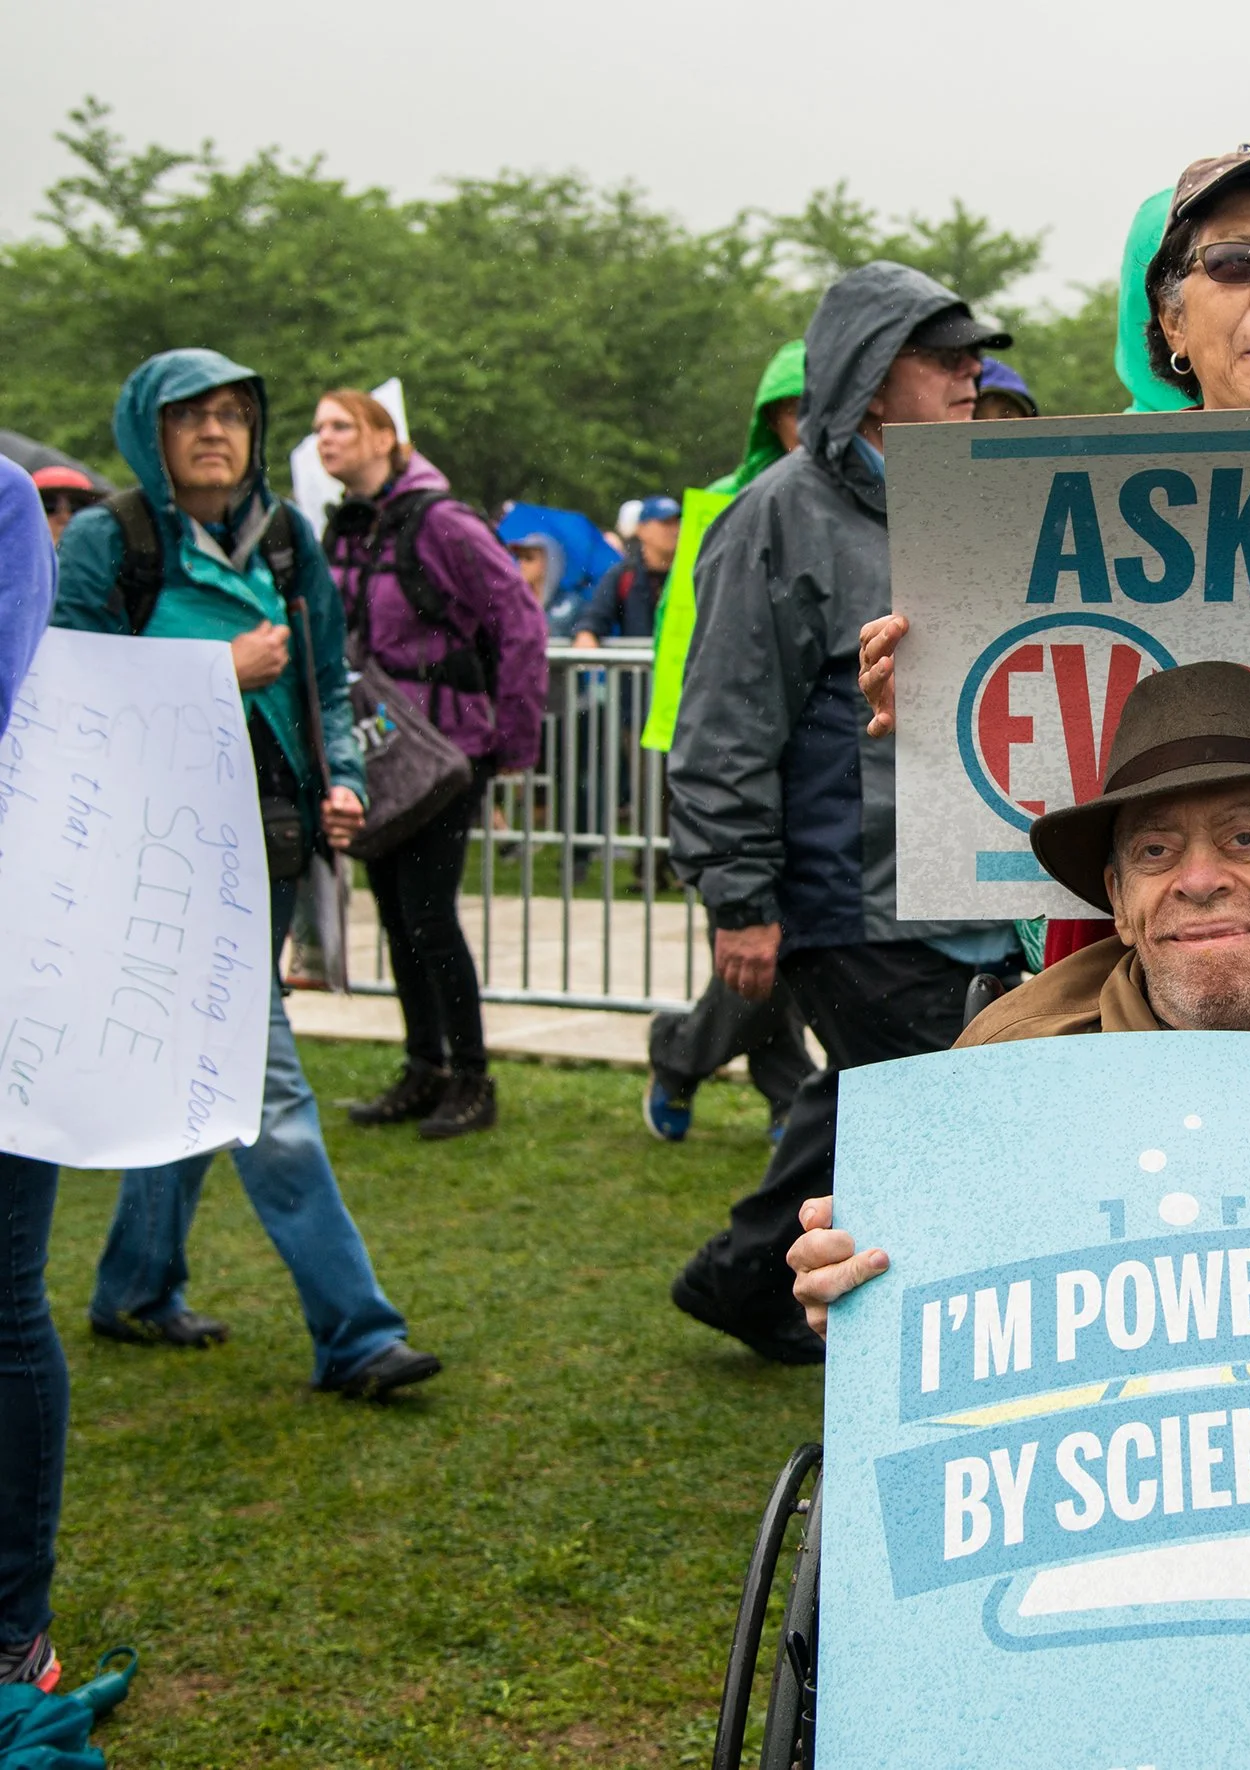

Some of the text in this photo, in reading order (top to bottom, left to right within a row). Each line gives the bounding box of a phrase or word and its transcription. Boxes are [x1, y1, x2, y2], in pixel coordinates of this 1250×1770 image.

[61, 771, 113, 851] that
[195, 823, 253, 915] good
[98, 796, 201, 1064] SCIENCE
[191, 934, 254, 1023] thing
[6, 1016, 68, 1107] True
[920, 1278, 1034, 1394] I'M
[943, 1441, 1040, 1561] BY
